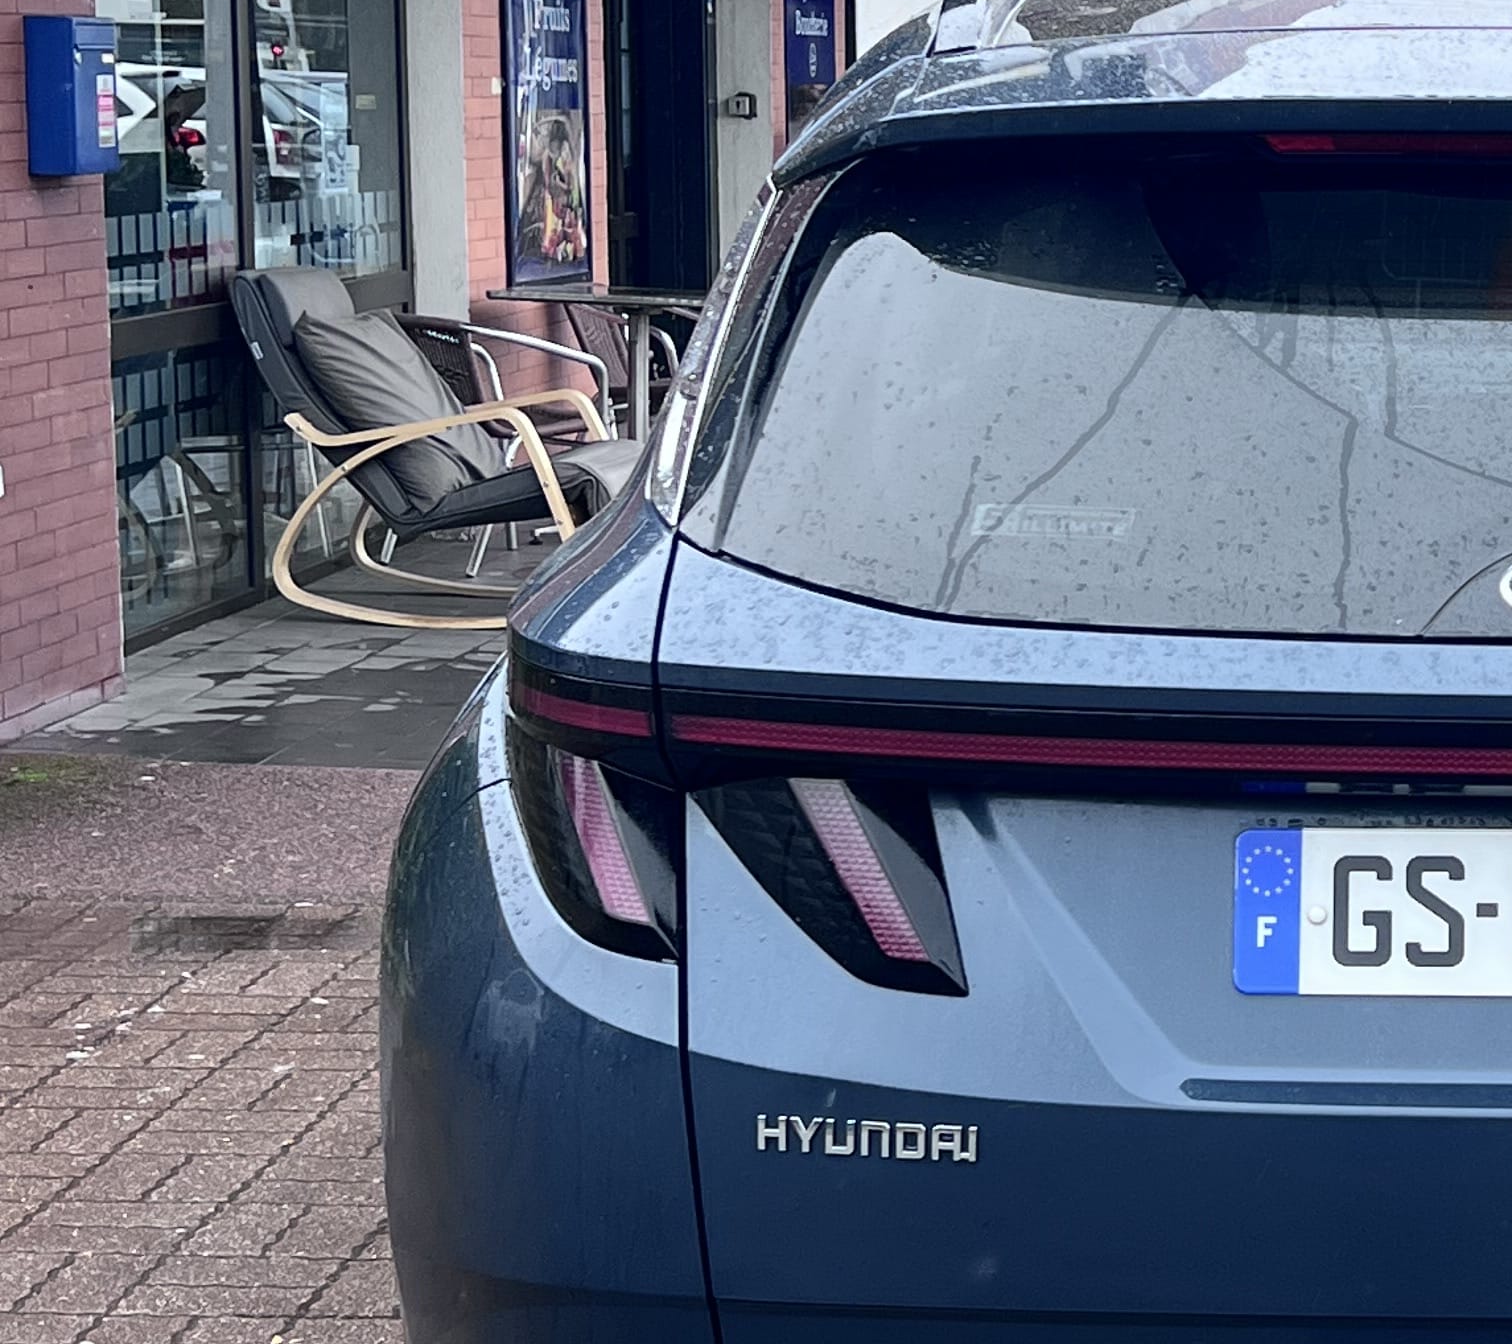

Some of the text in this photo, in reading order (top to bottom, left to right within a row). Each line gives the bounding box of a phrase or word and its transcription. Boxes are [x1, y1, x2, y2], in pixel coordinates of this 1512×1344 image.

[524, 48, 578, 92] Légumes
[1256, 916, 1277, 948] F
[757, 1114, 978, 1162] HYUNDAI
